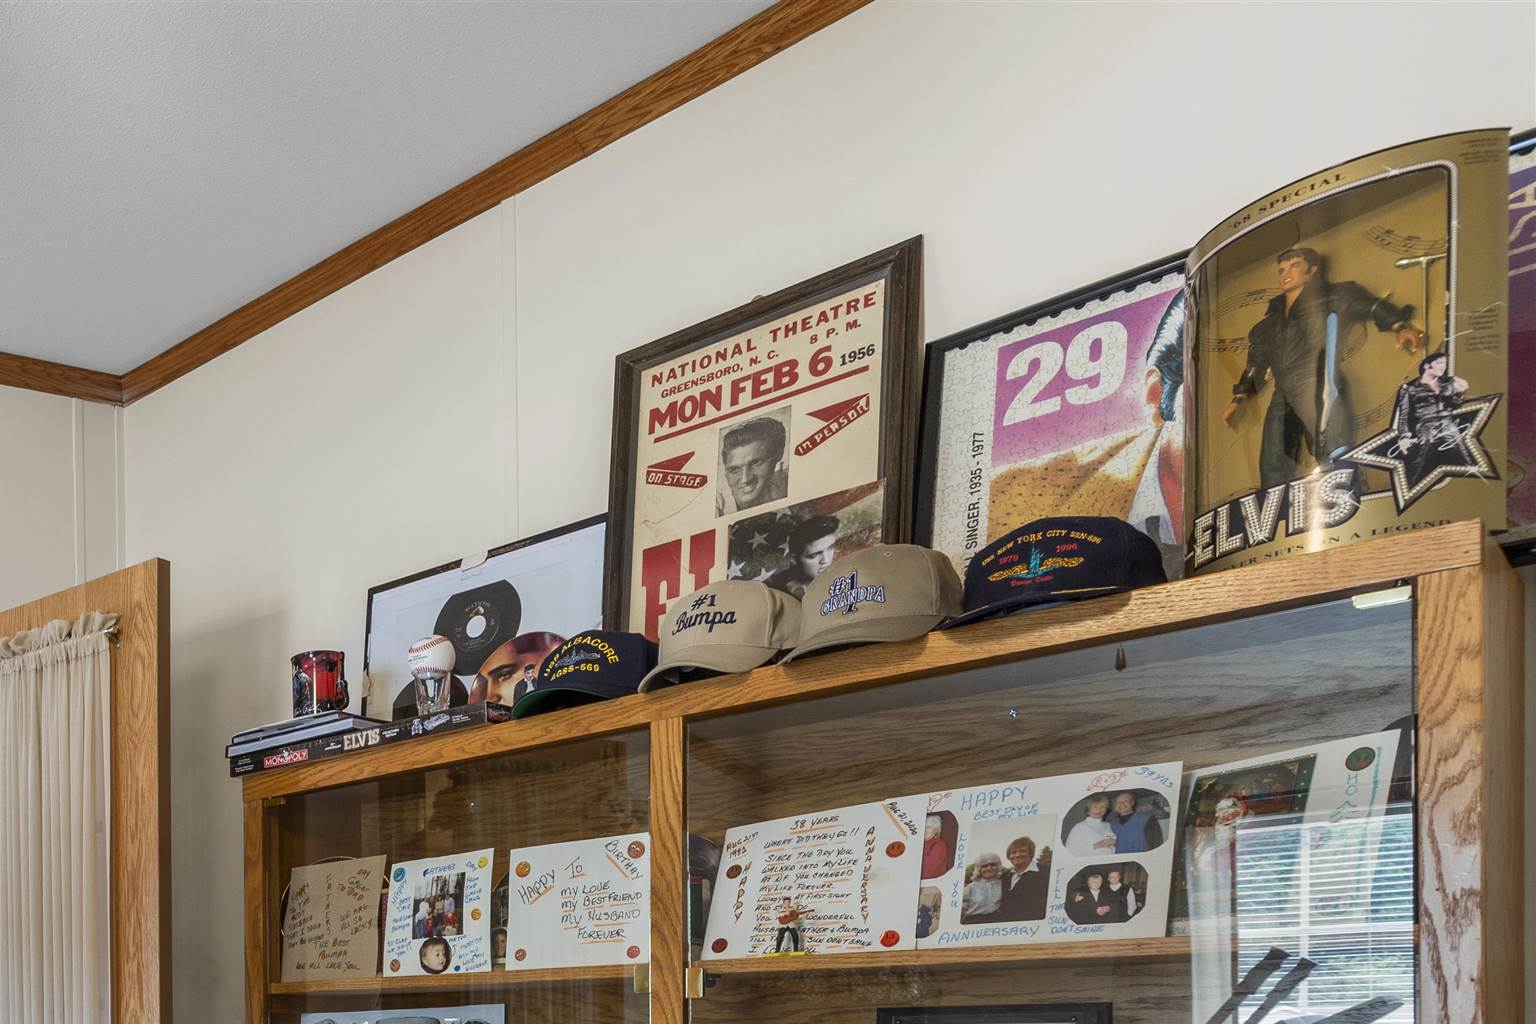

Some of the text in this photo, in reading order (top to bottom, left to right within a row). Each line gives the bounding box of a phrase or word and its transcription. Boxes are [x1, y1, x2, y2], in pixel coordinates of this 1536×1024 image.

[1258, 173, 1347, 215] SPECIAL
[651, 291, 877, 388] NATIONAL THEATRE
[809, 319, 861, 345] 8 P. M.
[660, 350, 779, 399] GREENSBORO, N. C.
[1002, 321, 1129, 428] 29
[648, 344, 875, 435] MON FEB 6 1956
[972, 432, 984, 461] 1977
[647, 472, 702, 488] ON STAGE
[969, 468, 983, 496] 1935
[965, 497, 983, 549] SINGER,
[1194, 468, 1361, 569] ELVIS
[997, 543, 1015, 556] NEW
[1017, 532, 1042, 544] YORK
[1046, 529, 1068, 538] CITY
[1264, 518, 1453, 562] SETS LEGEND
[691, 594, 716, 610] #1
[820, 584, 886, 616] GRANDPA
[672, 608, 737, 636] Bumpa
[561, 636, 620, 664] ALBACORE
[343, 728, 380, 750] ELVIS
[265, 751, 308, 767] MONOPOLY
[961, 785, 1028, 811] HAPPY
[811, 815, 840, 828] YEARS
[974, 807, 1003, 821] BEST
[764, 839, 793, 849] WHERE
[764, 854, 792, 862] SINCE
[797, 850, 814, 860] THE
[836, 848, 854, 856] YOU
[761, 863, 796, 874] WALKED
[812, 869, 854, 879] CHANGED
[517, 869, 555, 905] HAPPY
[583, 891, 642, 907] BEST FRIEND
[588, 909, 641, 922] HUSBAND
[577, 928, 627, 940] FOREVER
[938, 925, 1040, 944] ANNIVERSARY
